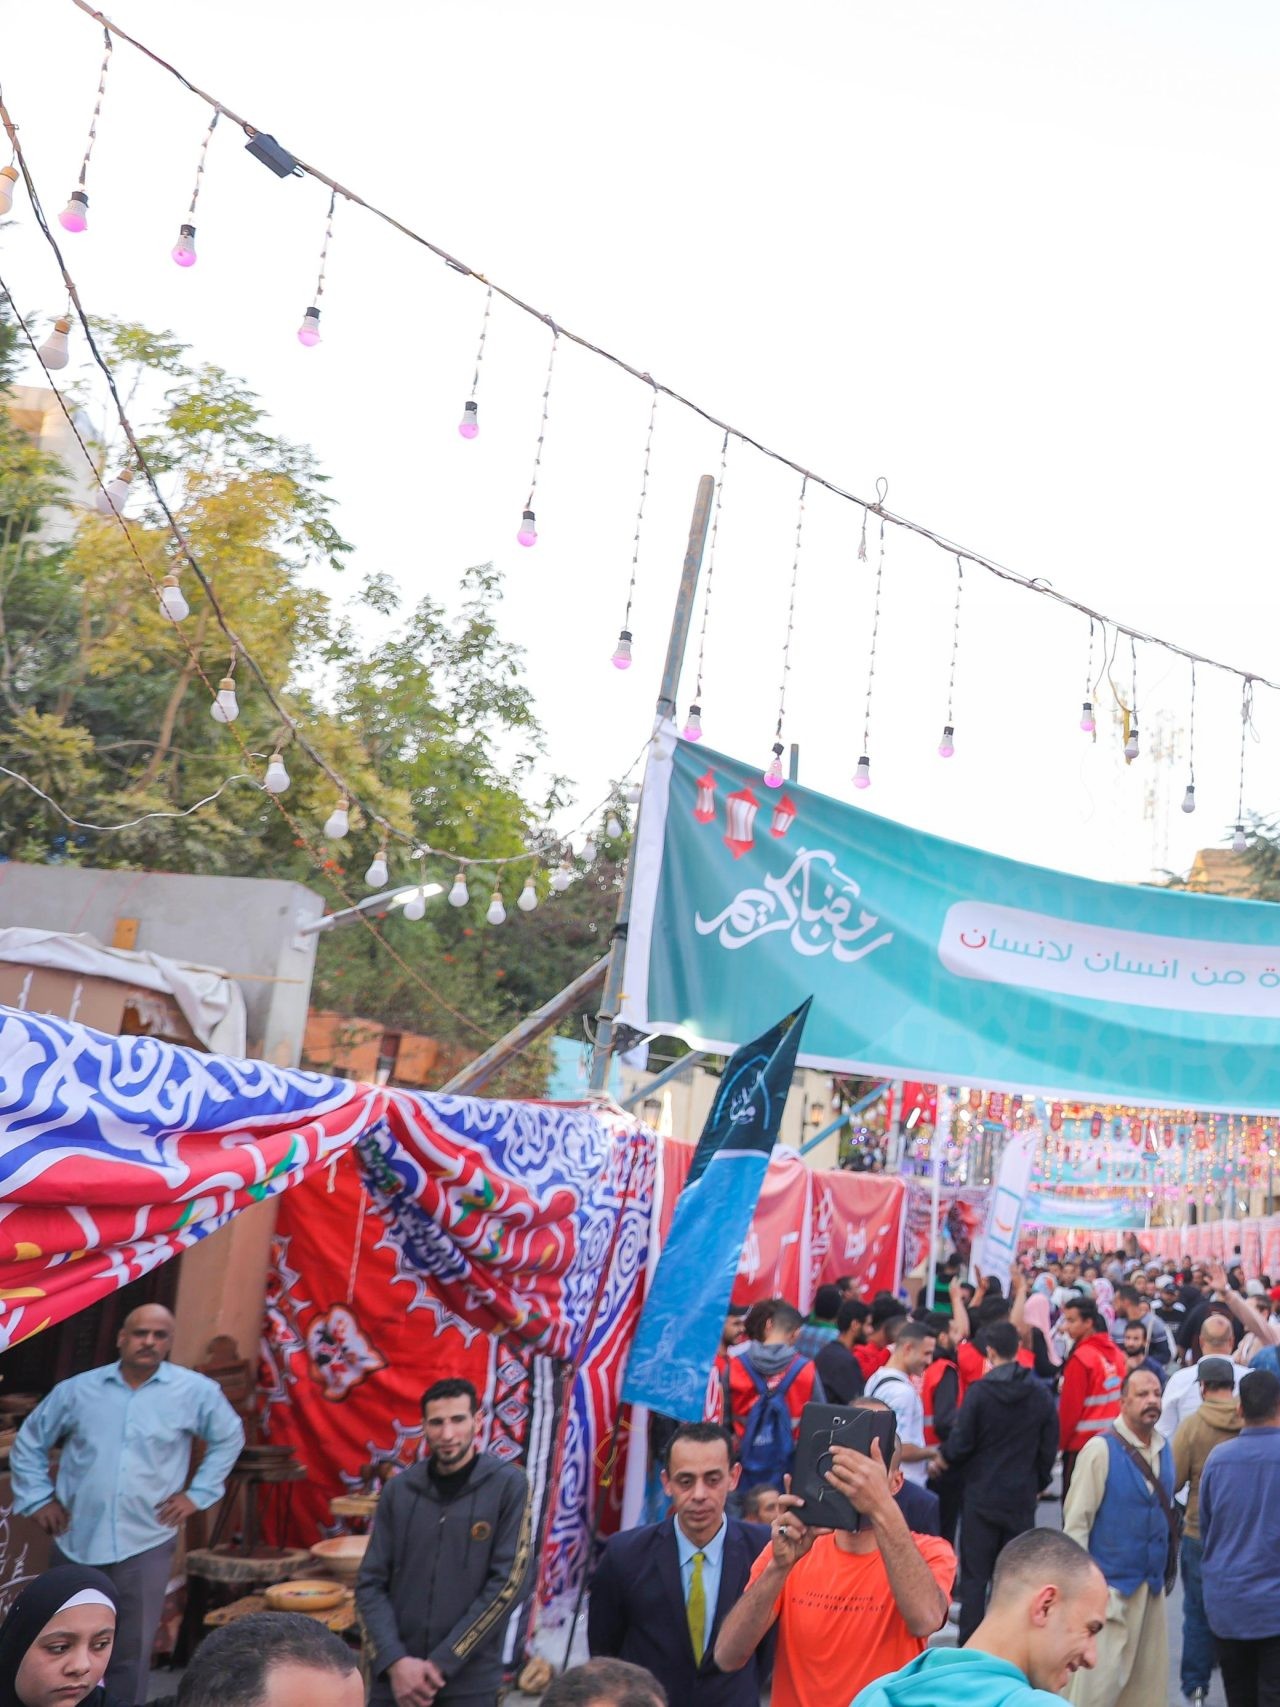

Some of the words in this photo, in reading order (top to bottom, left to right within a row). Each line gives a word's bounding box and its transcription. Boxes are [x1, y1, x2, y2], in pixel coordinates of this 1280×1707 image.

[695, 846, 836, 949] كريم
[790, 860, 894, 963] رمضان
[960, 928, 1073, 963] لانسان
[1084, 951, 1178, 980] انسان
[1191, 966, 1246, 987] من
